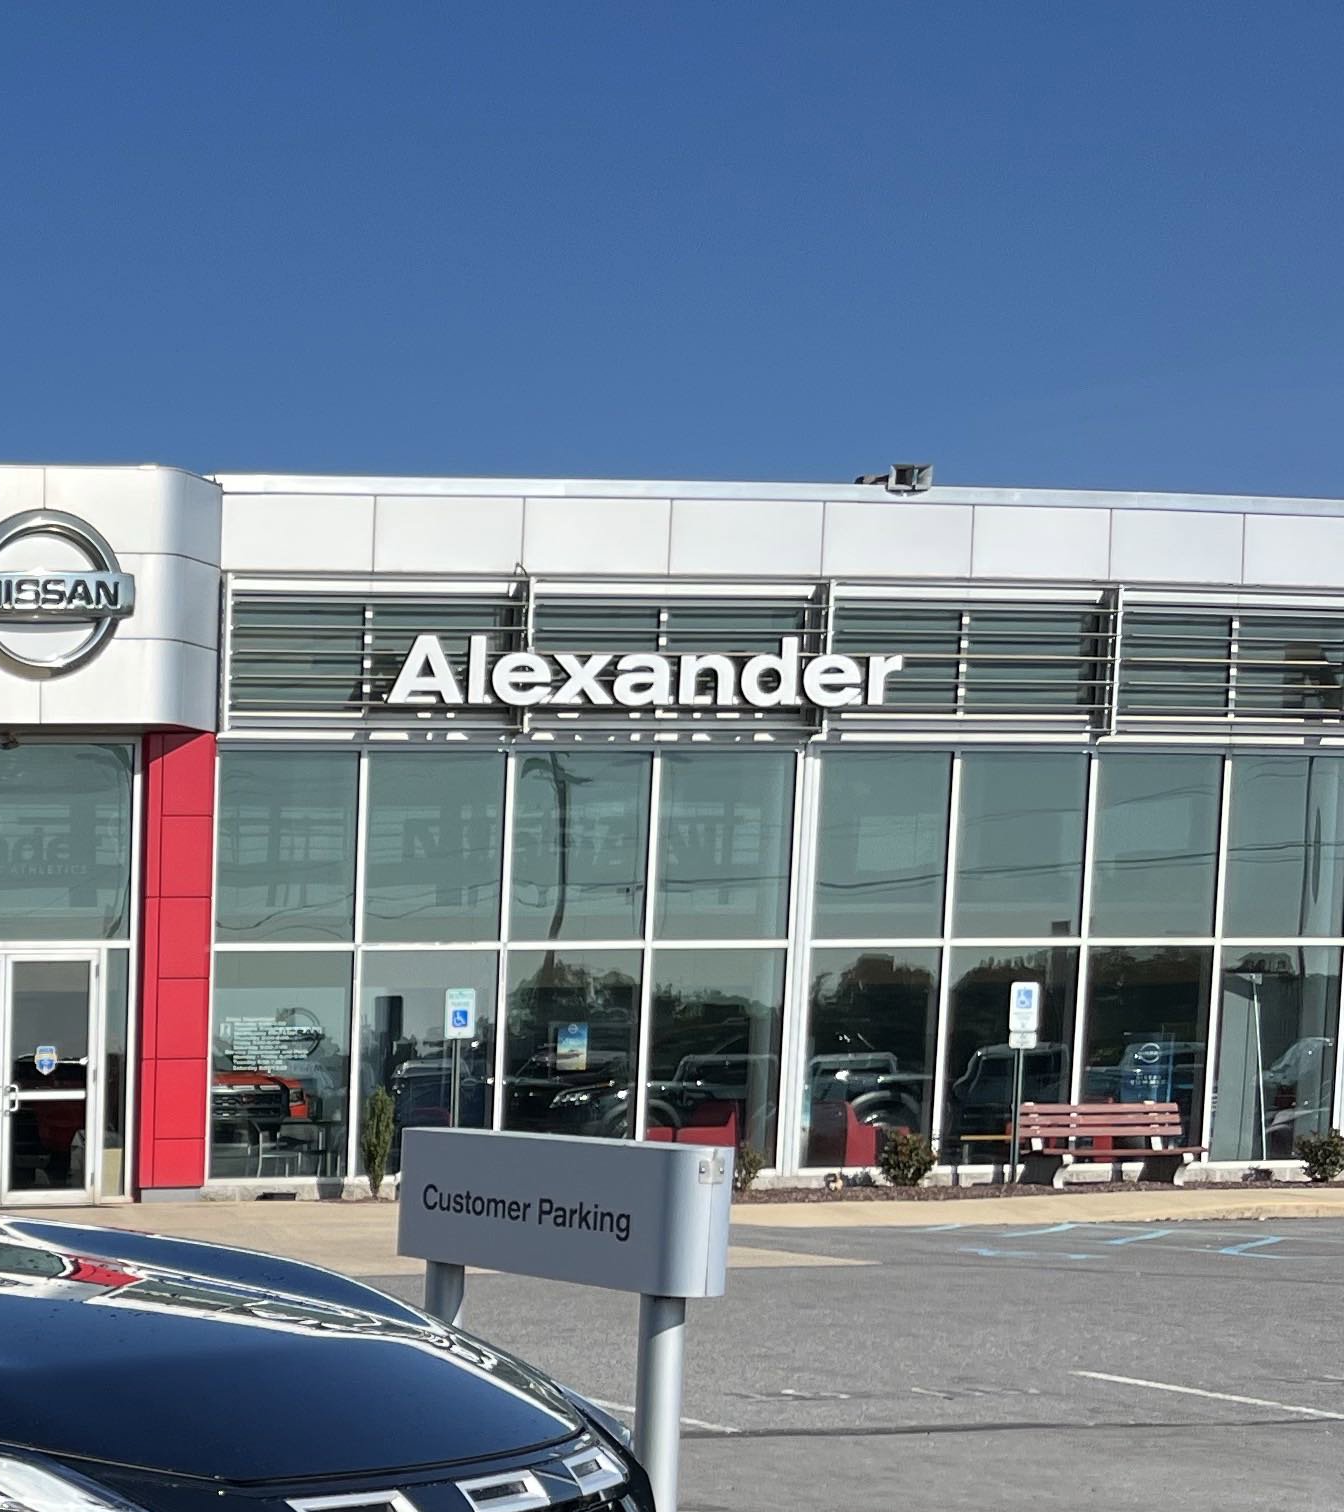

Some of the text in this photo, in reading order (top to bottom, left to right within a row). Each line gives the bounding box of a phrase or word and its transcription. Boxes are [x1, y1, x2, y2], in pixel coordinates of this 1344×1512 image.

[386, 634, 904, 707] Alexander
[422, 1184, 631, 1242] Customer Parking
